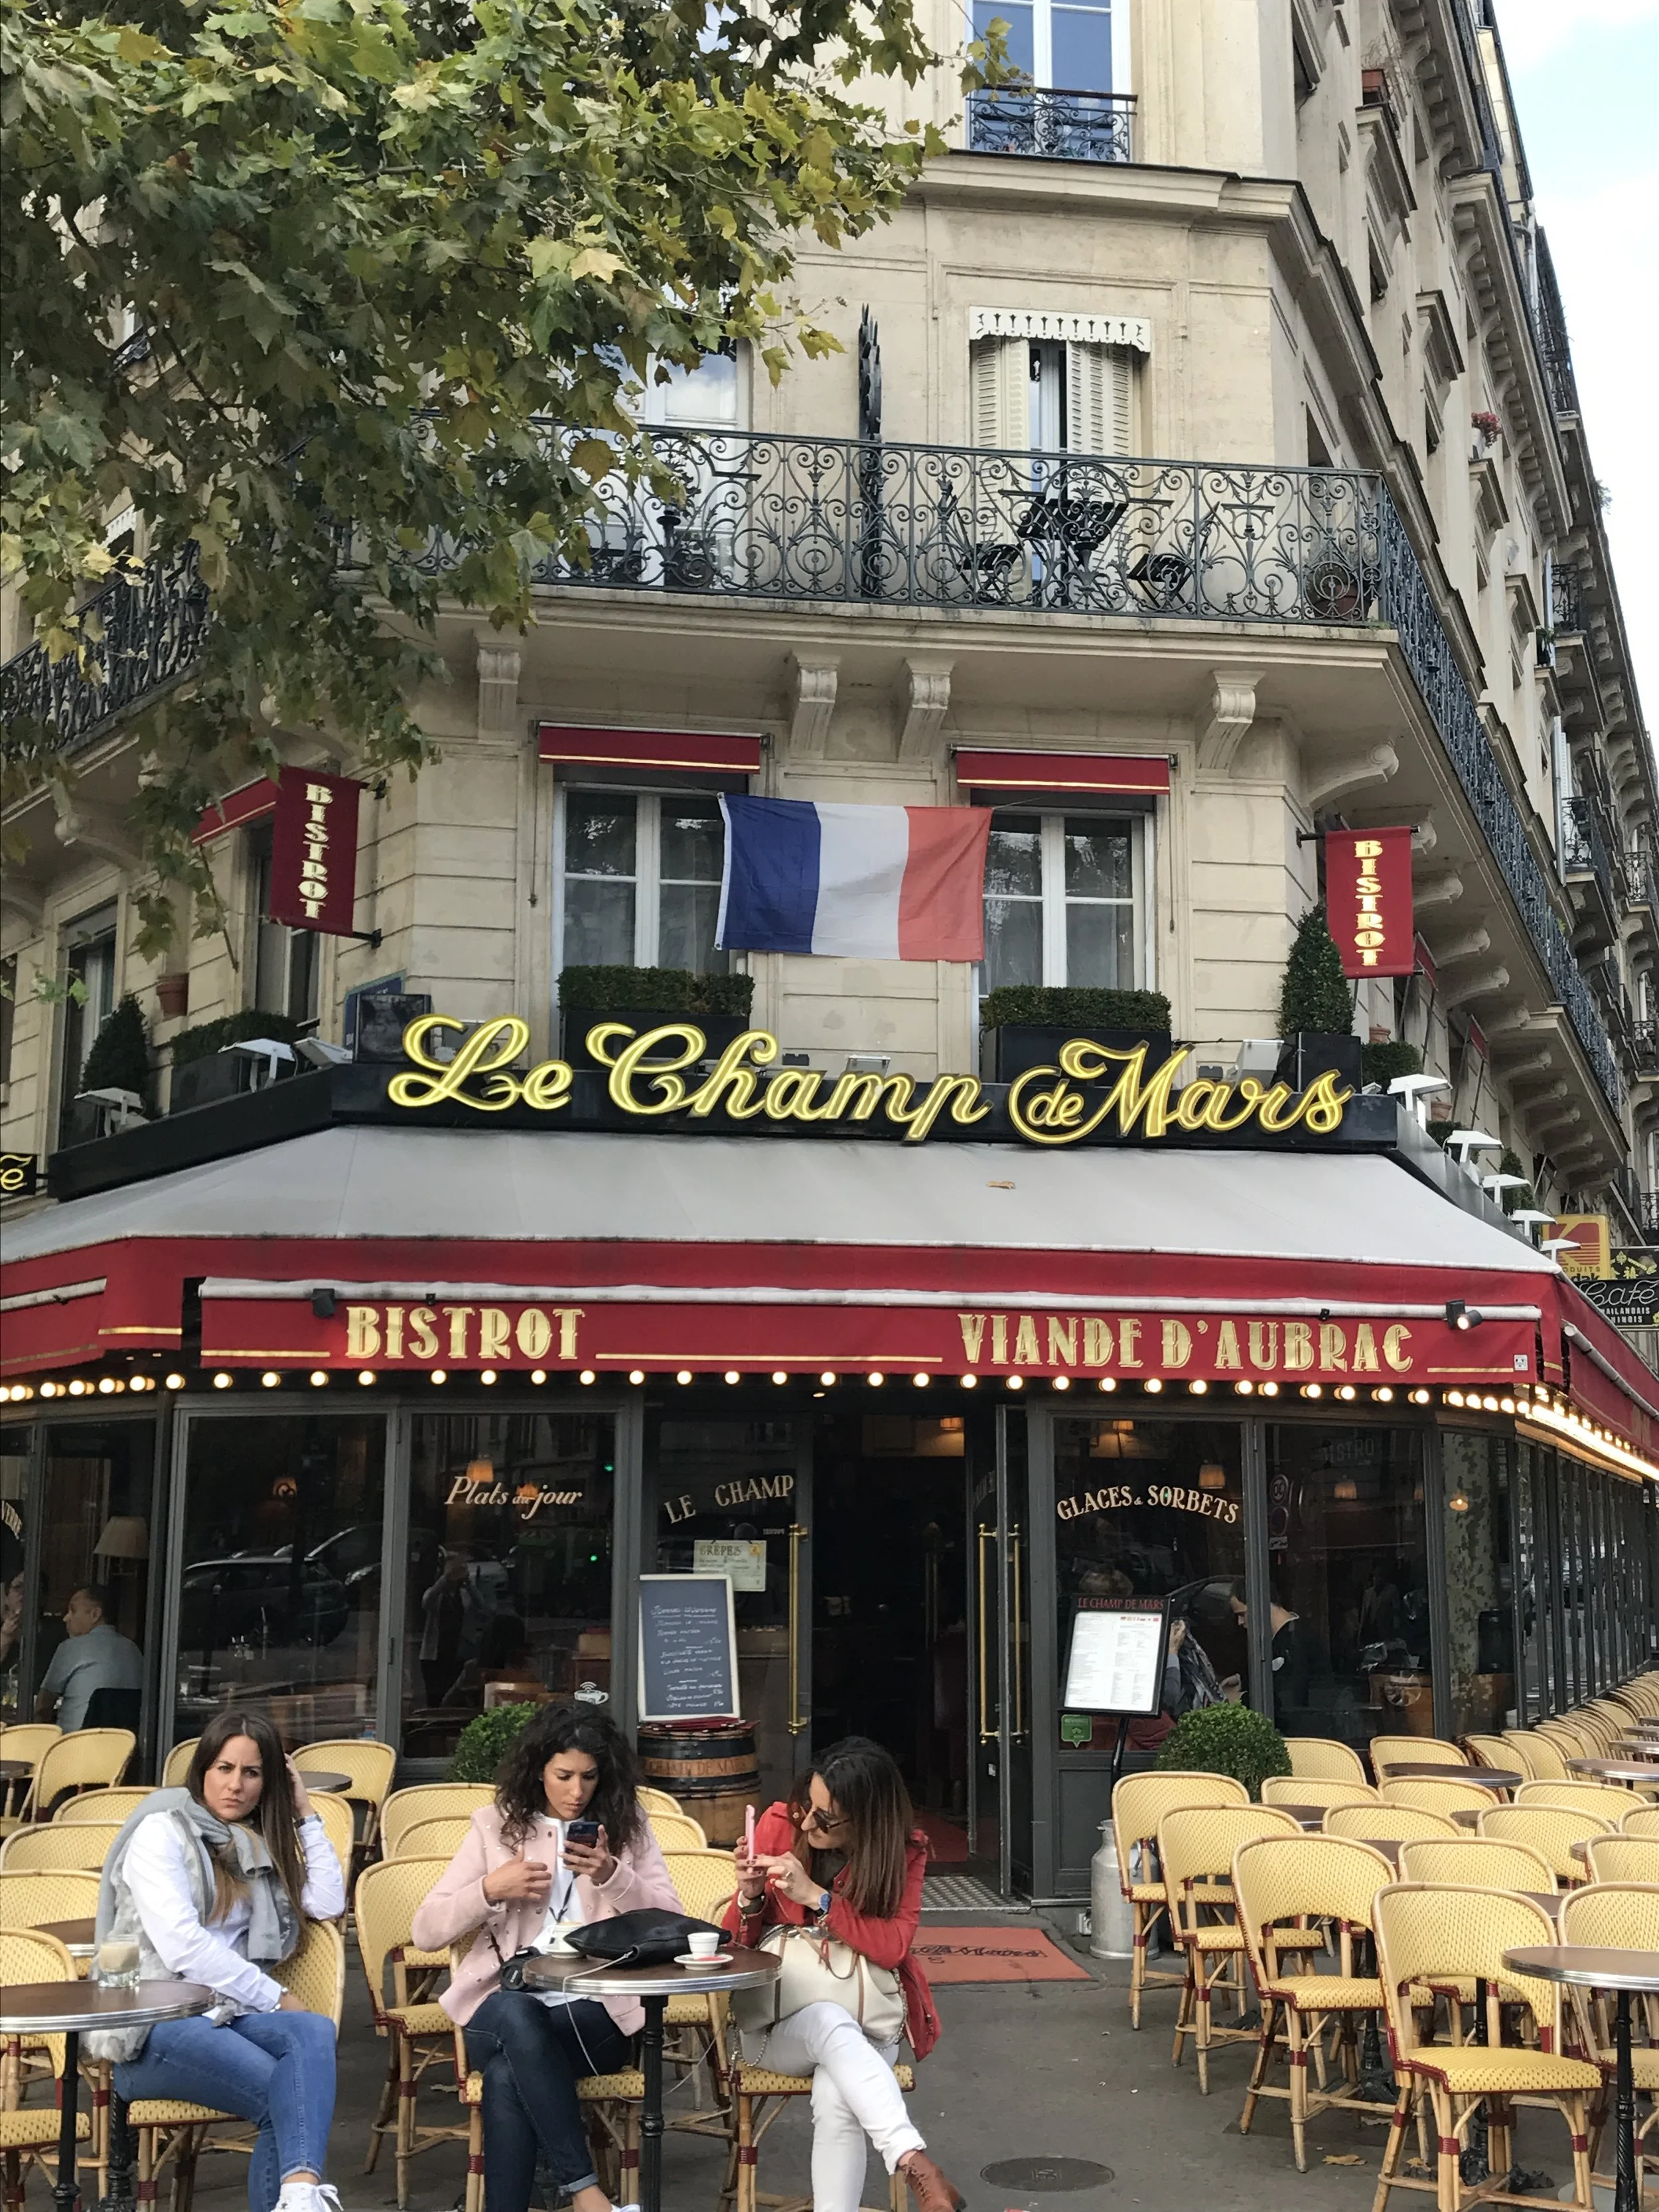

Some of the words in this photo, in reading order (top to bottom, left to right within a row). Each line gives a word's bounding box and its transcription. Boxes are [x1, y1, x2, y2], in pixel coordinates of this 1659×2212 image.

[298, 783, 333, 919] BISTROT
[1354, 840, 1386, 966] BISTROT
[388, 1013, 573, 1112] Le
[585, 1022, 994, 1142] Champ
[1008, 1037, 1356, 1144] Mars
[1026, 1078, 1084, 1128] de
[1579, 1280, 1659, 1307] Café
[346, 1306, 585, 1360] BISTROT
[958, 1313, 1143, 1368] VIANDE
[1160, 1319, 1413, 1372] D'AUBRAC
[444, 1476, 510, 1505] Plats
[521, 1484, 583, 1520] jour
[664, 1495, 696, 1524] LE
[715, 1475, 794, 1507] CHAMP
[1057, 1485, 1133, 1520] GLACES
[1147, 1485, 1239, 1524] SORBETS
[1078, 1597, 1088, 1609] LE
[1089, 1597, 1123, 1609] CHAMP
[1125, 1598, 1137, 1610] DE
[1138, 1598, 1165, 1610] MARS
